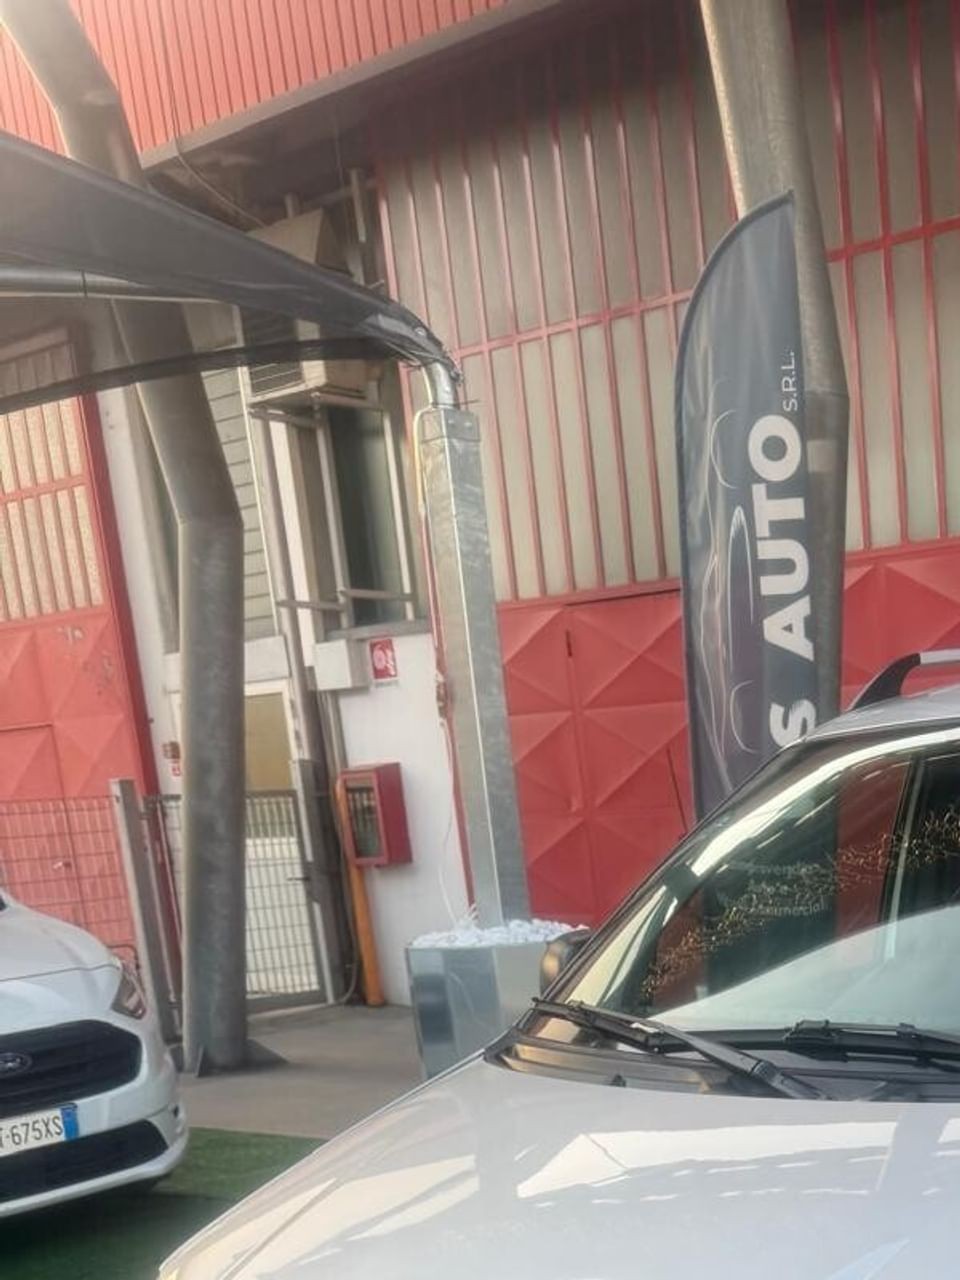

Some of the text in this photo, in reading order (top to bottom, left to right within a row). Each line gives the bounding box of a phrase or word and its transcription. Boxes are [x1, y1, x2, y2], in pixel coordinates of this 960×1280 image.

[781, 350, 799, 412] S.R.L.
[748, 414, 815, 662] AUTO
[10, 1115, 63, 1146] 675XS
